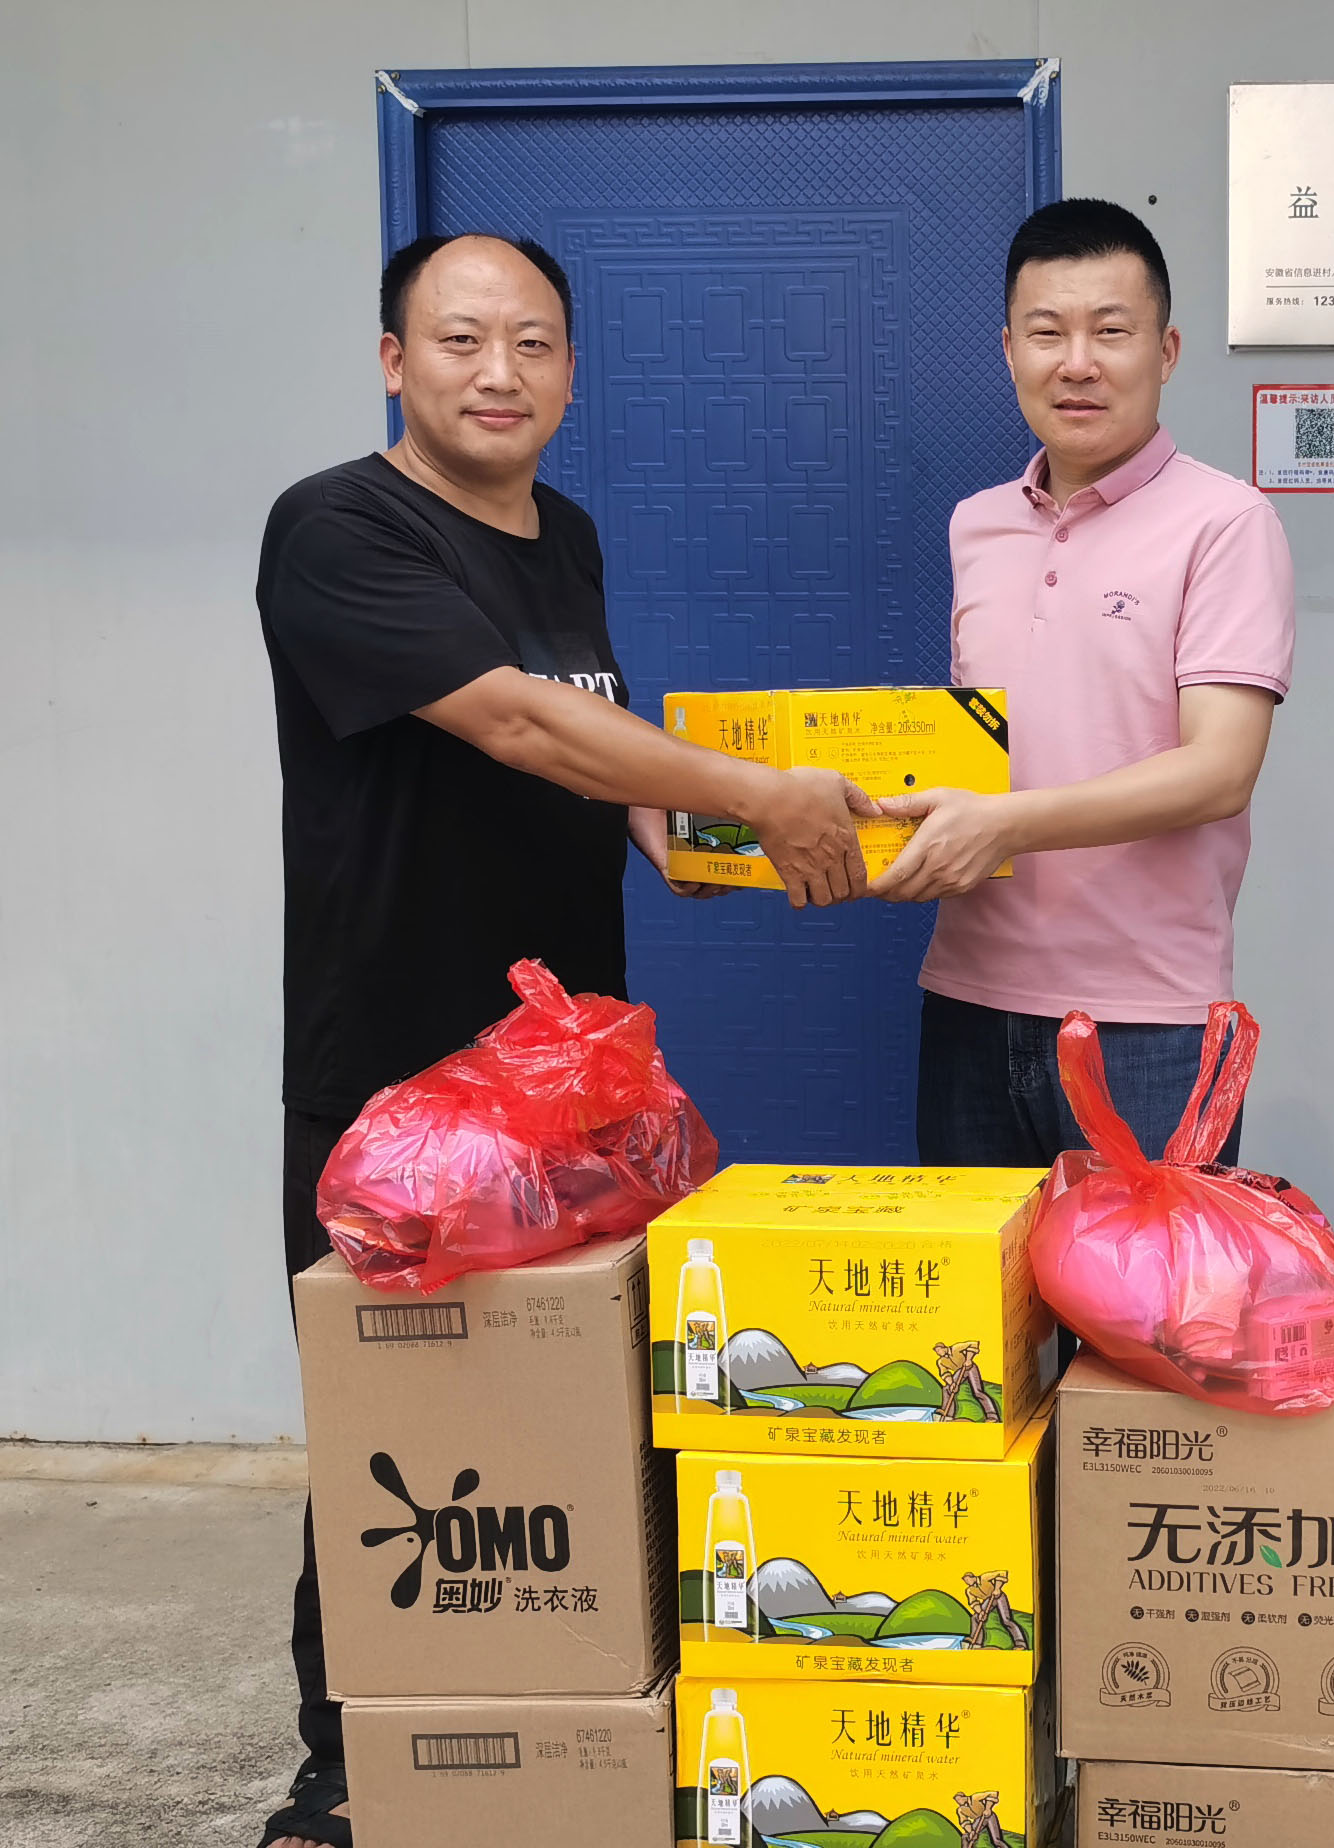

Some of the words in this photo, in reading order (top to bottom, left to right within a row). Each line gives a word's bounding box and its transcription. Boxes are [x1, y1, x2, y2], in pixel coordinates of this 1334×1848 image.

[819, 711, 861, 727] 天地精华
[719, 717, 768, 751] 天地精华
[809, 1258, 940, 1298] 天地精华
[808, 1300, 857, 1312] Natural
[859, 1301, 904, 1313] mineral
[906, 1305, 940, 1314] water
[828, 1319, 918, 1332] 饮用天然矿泉水
[767, 1427, 886, 1445] 矿泉宝藏发现者
[1083, 1427, 1214, 1462] 幸福阳光
[1083, 1462, 1142, 1474] E3L3150WEC
[837, 1490, 969, 1528] 天地精华
[435, 1504, 571, 1574] OMO
[837, 1530, 887, 1542] Natural
[888, 1531, 933, 1543] mineral
[934, 1535, 968, 1544] water
[857, 1549, 947, 1561] 饮用天然矿泉水
[1128, 1568, 1274, 1596] ADDITIVES
[432, 1578, 503, 1614] 奥妙
[514, 1585, 599, 1613] 洗衣液
[795, 1655, 914, 1673] 矿泉宝藏发现者
[831, 1709, 960, 1749] 天地精华
[831, 1749, 880, 1761] Natural
[880, 1751, 926, 1763] mineral
[926, 1755, 960, 1764] water
[1098, 1797, 1227, 1834] 幸福阳光
[1098, 1832, 1156, 1844] E3L3150WEC
